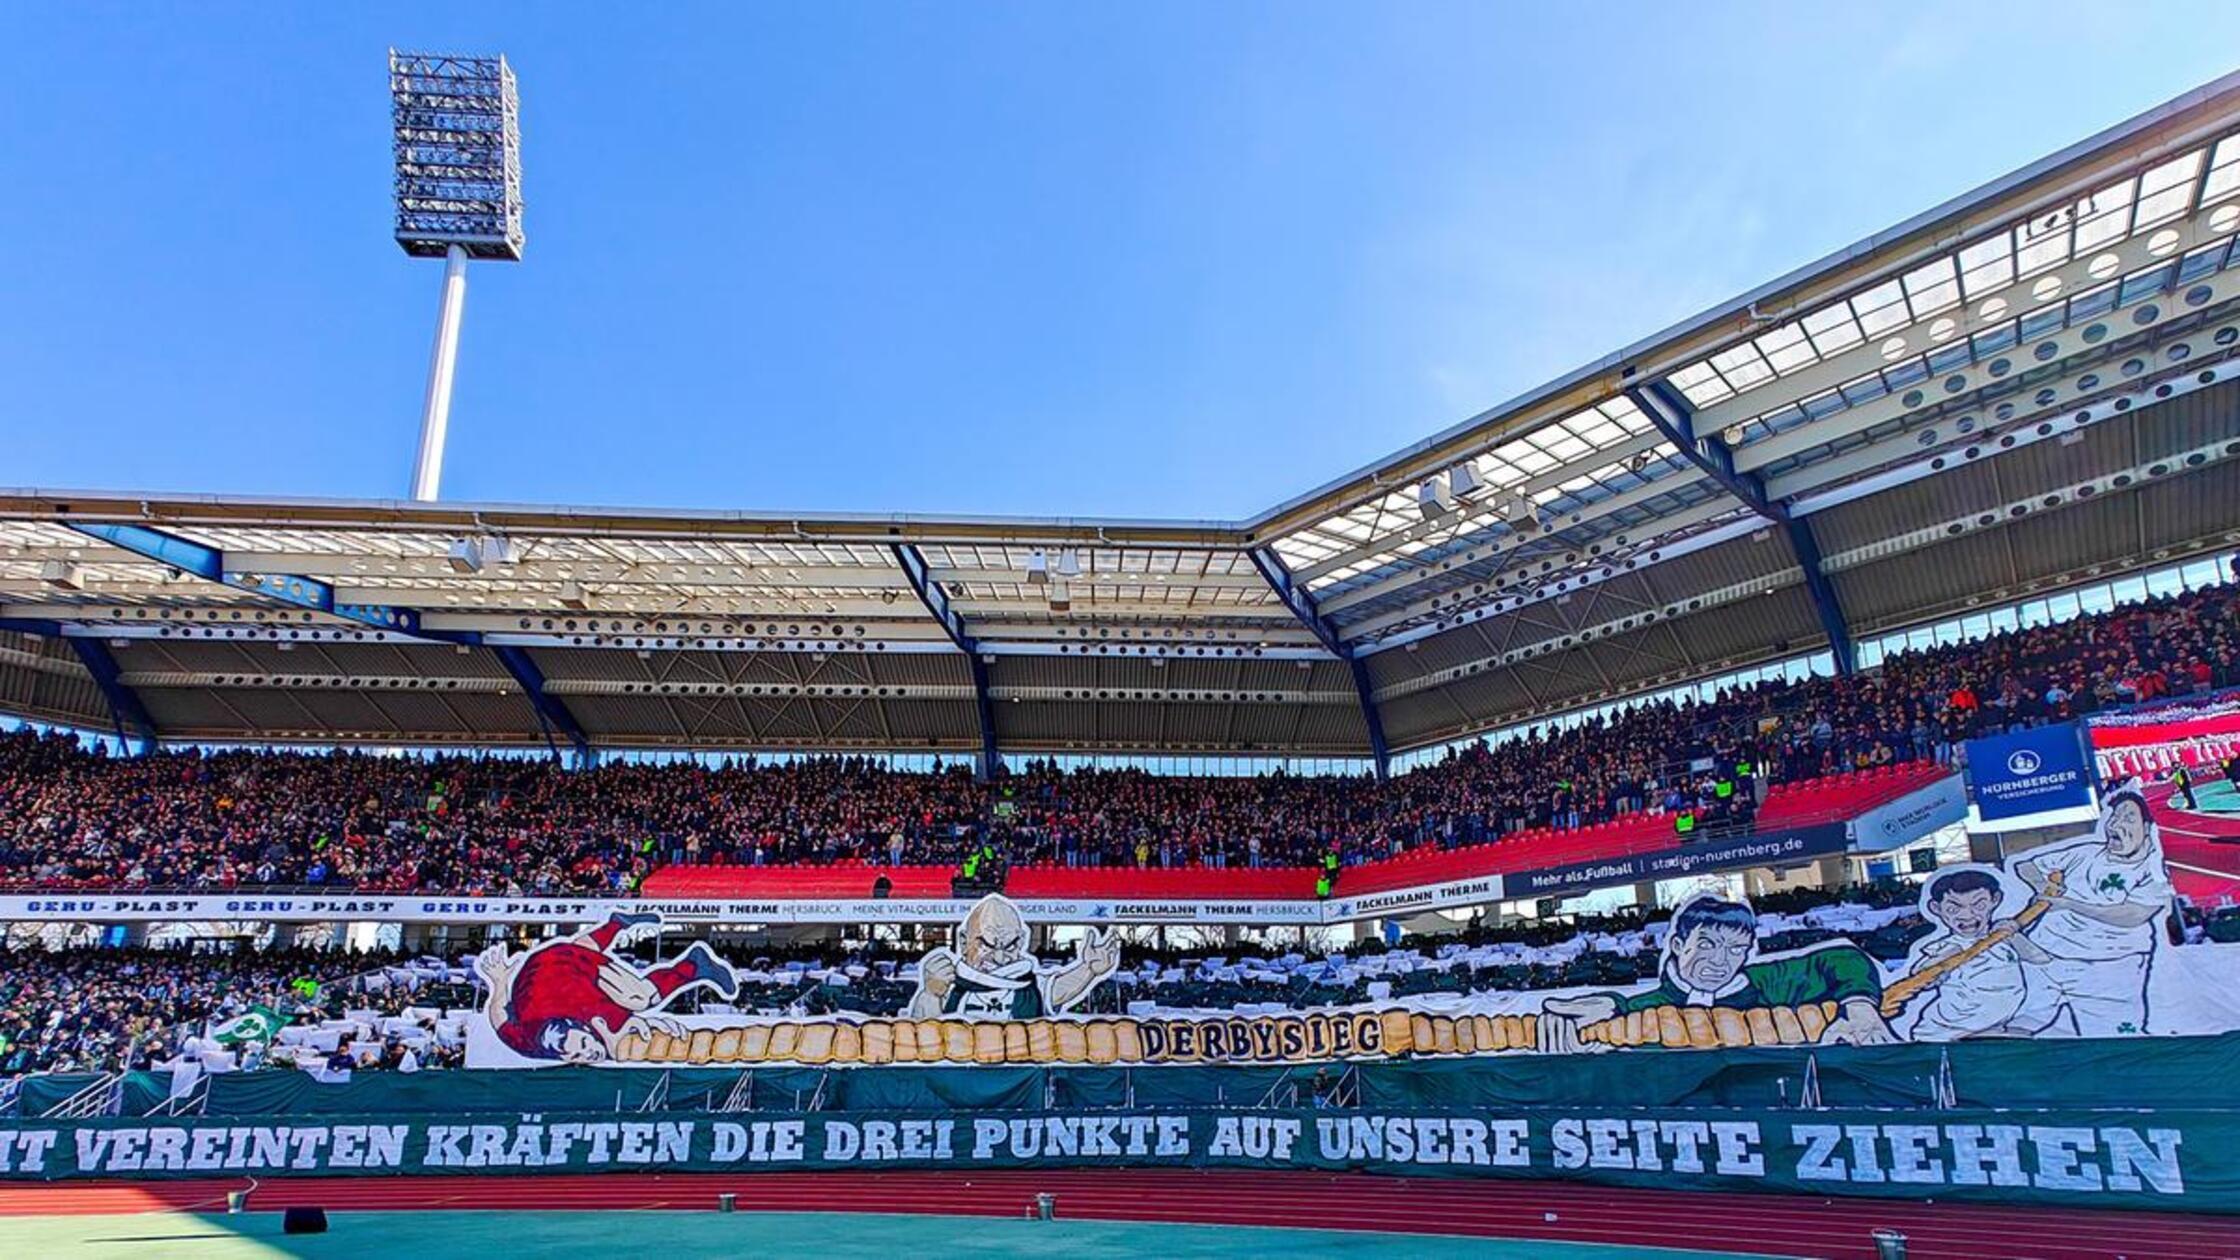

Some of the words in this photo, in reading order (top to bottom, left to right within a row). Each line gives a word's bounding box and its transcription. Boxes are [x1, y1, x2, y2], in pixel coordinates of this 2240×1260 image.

[1531, 874, 1562, 888] Mehr
[1565, 870, 1583, 883] als
[1583, 862, 1633, 881] Fußball
[1651, 838, 1804, 871] stadion-nuernberg.de
[1356, 890, 1433, 910] FACKELMANN
[1440, 882, 1490, 899] THERME
[635, 904, 720, 914] FACKELMANN
[729, 904, 778, 914] THERME
[781, 904, 842, 915] HERSBRUCK
[852, 904, 884, 915] MEINE
[888, 904, 956, 915] VITALQUELLE
[1049, 905, 1077, 914] LAND
[1114, 904, 1198, 914] FACKELMANN
[1204, 905, 1252, 915] THERME
[1255, 905, 1315, 915] HERSBRUCK
[1142, 1011, 1381, 1057] DERBYSIEG
[75, 1125, 409, 1171] VEREINTEN
[423, 1114, 694, 1166] KRÄFTEN
[710, 1120, 805, 1161] DIE
[824, 1120, 955, 1160] DREI
[972, 1116, 1189, 1158] PUNKTE
[1208, 1117, 1301, 1160] AUF
[1316, 1116, 1530, 1166] UNSERE
[1552, 1118, 1765, 1176] SEITE
[1791, 1124, 2184, 1194] ZIEHEN
